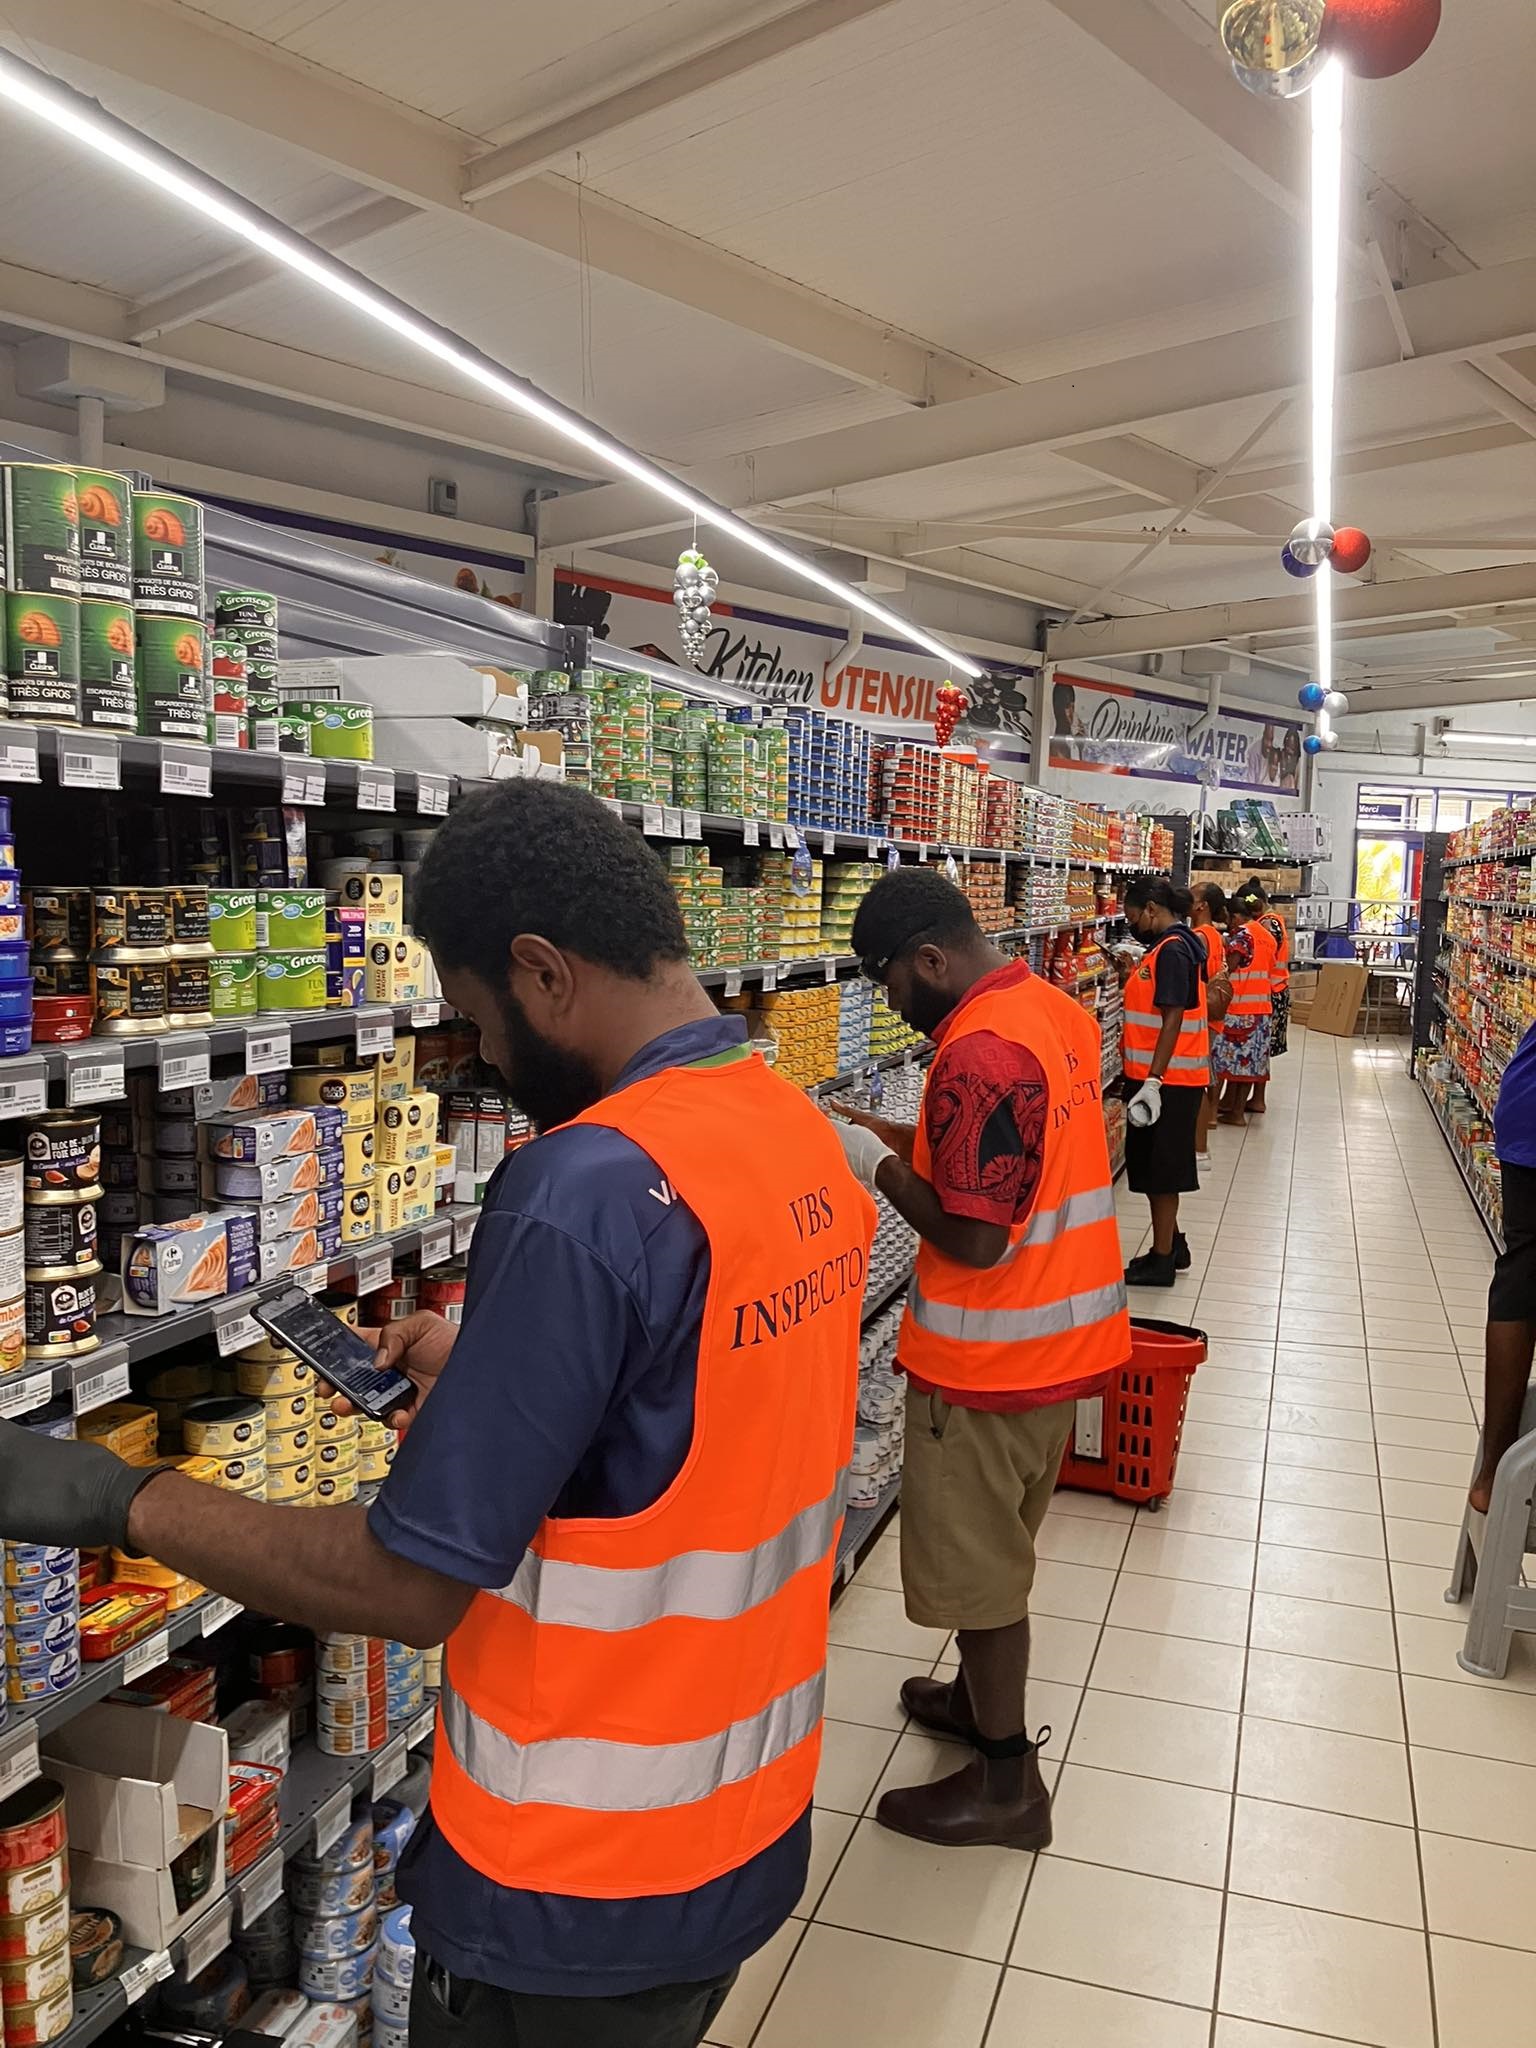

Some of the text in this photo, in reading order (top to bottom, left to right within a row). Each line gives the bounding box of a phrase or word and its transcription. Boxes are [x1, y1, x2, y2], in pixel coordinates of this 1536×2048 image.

[101, 569, 127, 583] GROS
[139, 584, 167, 597] TRÈS
[168, 587, 195, 600] GROS
[694, 628, 938, 722] Kitchen UTENSIL
[11, 685, 71, 700] TRÈS GROS
[99, 696, 123, 709] TRÈS
[168, 707, 191, 719] TRÈS
[1090, 698, 1249, 767] Drinking WATER
[511, 1114, 523, 1123] Tuna
[51, 1142, 68, 1150] BLOC
[69, 1139, 78, 1147] DE
[52, 1146, 86, 1159] FOIE GRAS
[789, 1186, 833, 1243] VBS
[730, 1243, 865, 1351] INSPECTO
